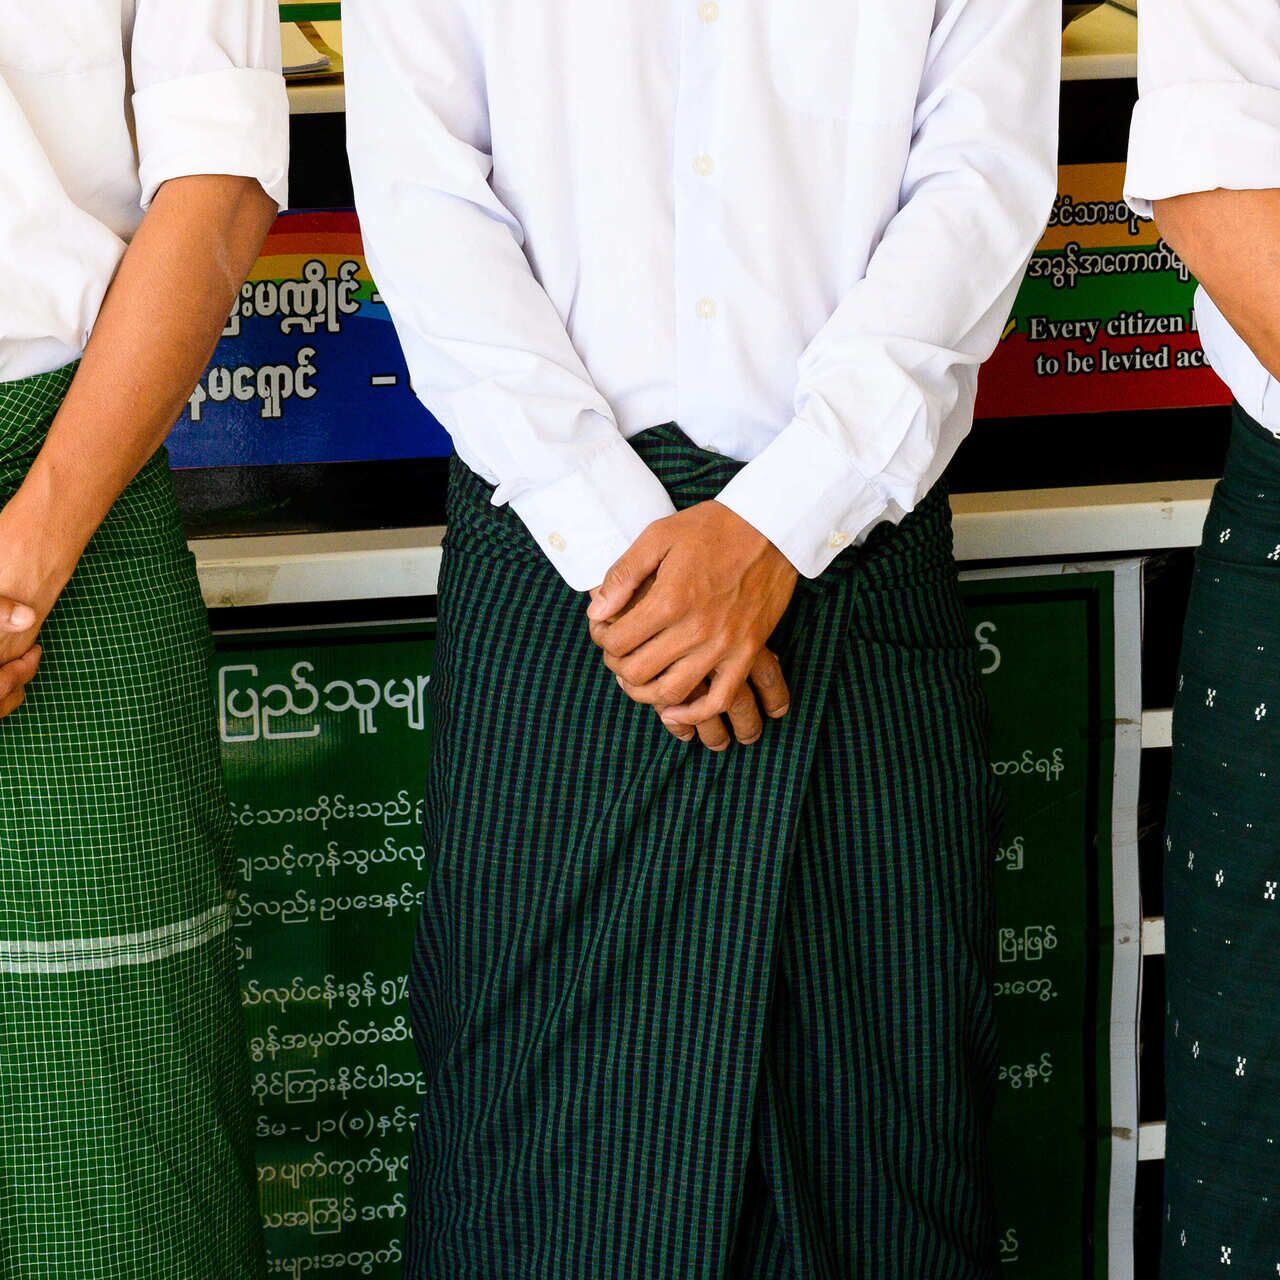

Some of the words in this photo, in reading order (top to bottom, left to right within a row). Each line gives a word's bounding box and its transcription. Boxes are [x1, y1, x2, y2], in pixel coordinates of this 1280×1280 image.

[1029, 316, 1102, 344] Every
[1106, 312, 1184, 336] citizen
[1036, 354, 1060, 376] to
[1066, 351, 1095, 373] be
[1100, 346, 1169, 372] levied
